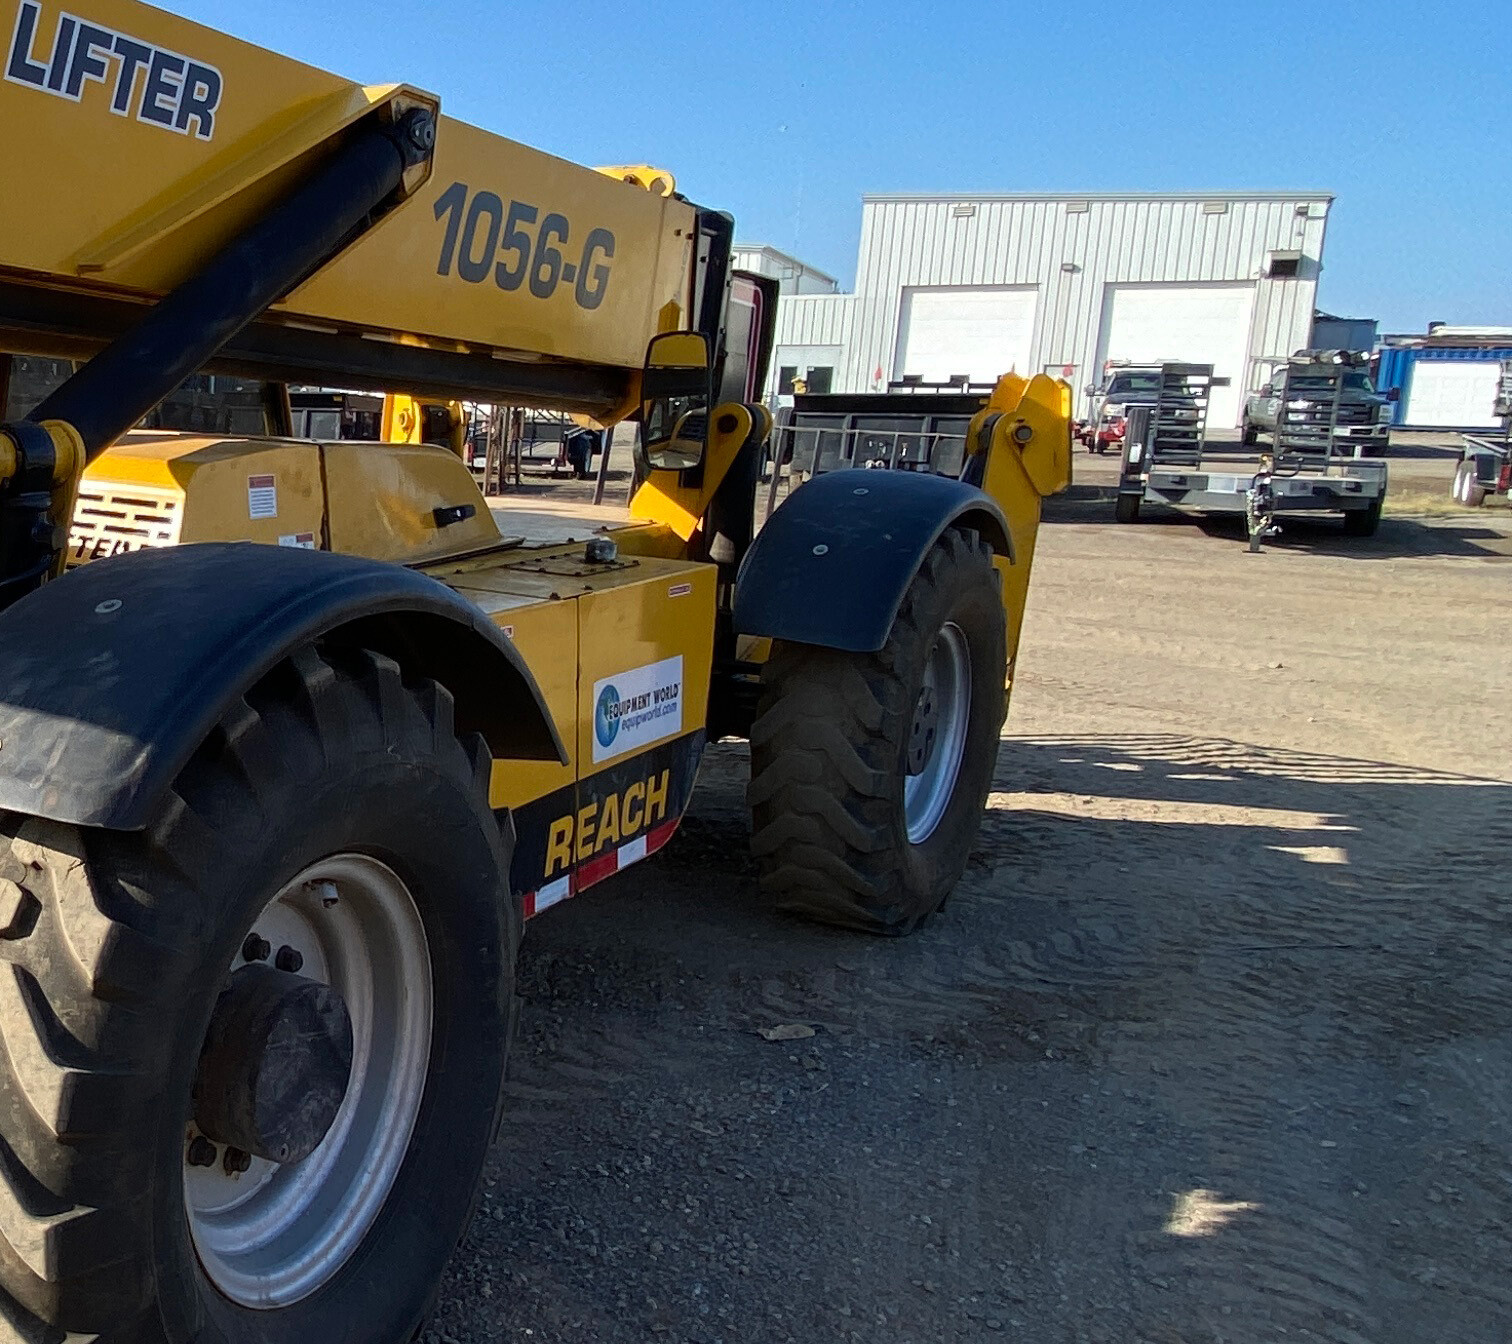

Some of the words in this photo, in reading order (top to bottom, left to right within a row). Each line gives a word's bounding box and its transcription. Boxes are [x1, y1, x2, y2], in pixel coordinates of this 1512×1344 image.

[433, 182, 616, 310] 1056-G
[609, 692, 651, 720] EQUIPMENT
[653, 683, 679, 704] WORLD
[621, 702, 677, 732] equipworld.com
[544, 769, 670, 878] REACH
